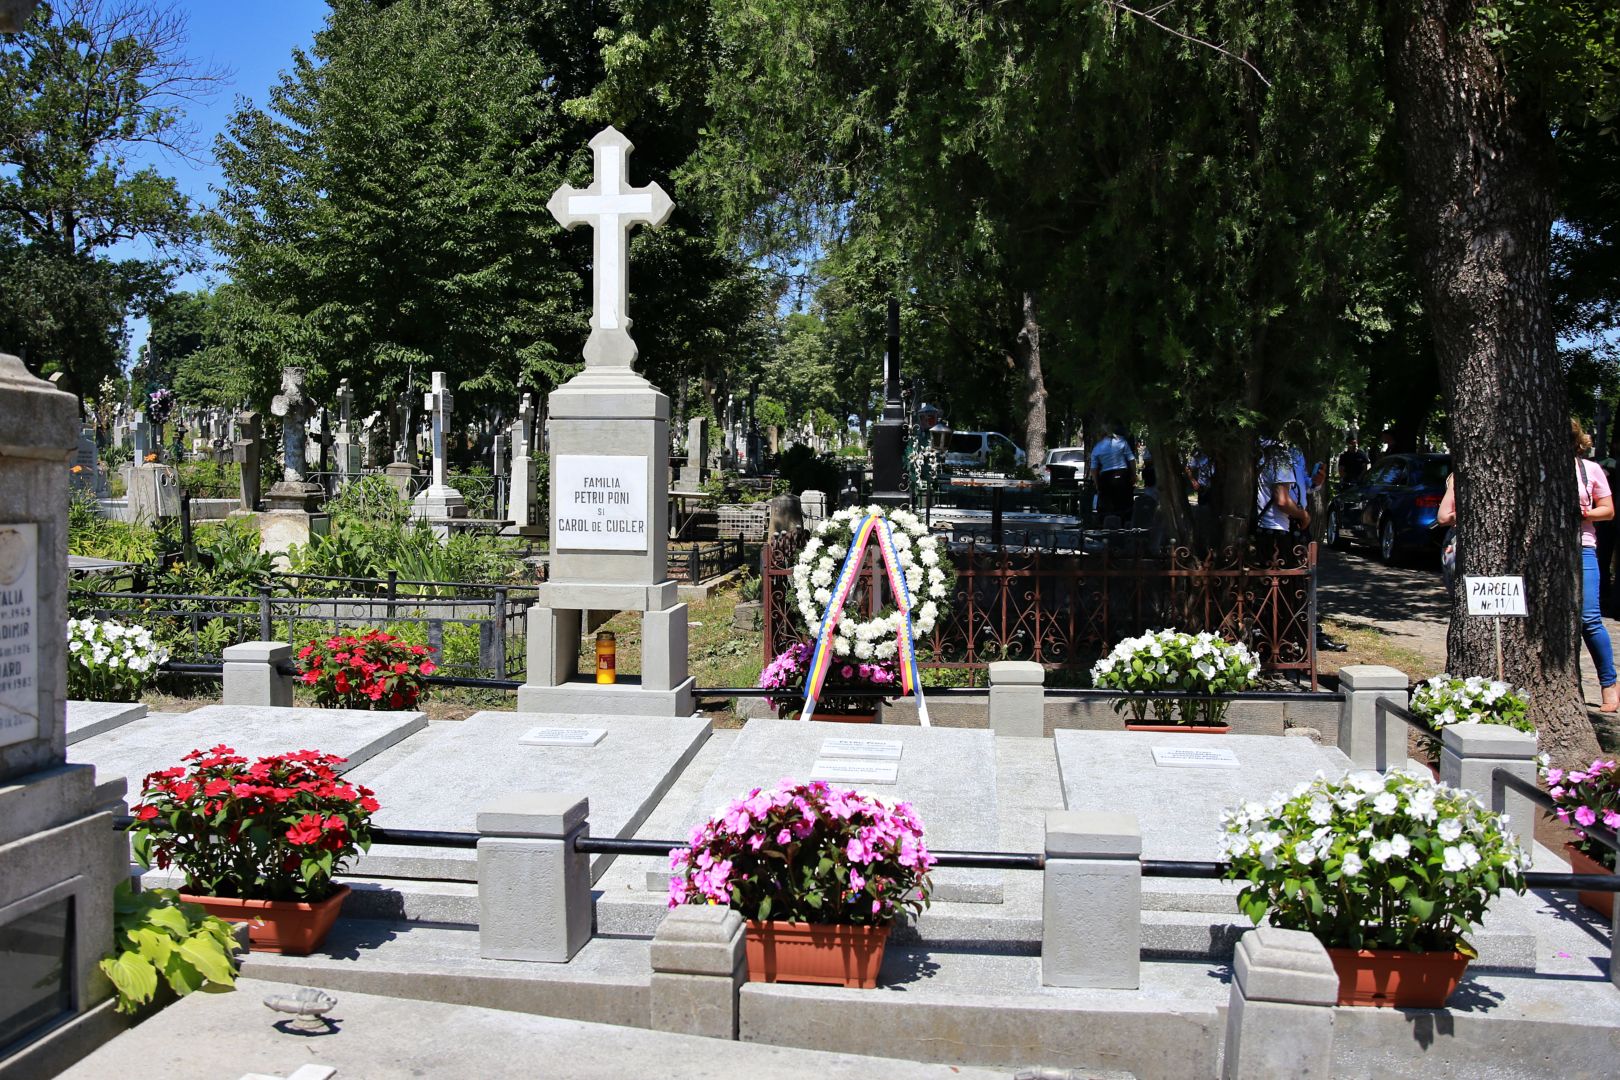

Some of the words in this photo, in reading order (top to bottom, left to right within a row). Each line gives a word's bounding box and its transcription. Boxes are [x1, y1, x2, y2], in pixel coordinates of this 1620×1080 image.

[583, 477, 621, 489] FAMILIA
[574, 491, 604, 504] PETRU
[607, 492, 630, 505] PONI
[558, 518, 589, 532] CAROL
[591, 521, 602, 532] DE
[606, 519, 644, 533] CUGLER
[1472, 582, 1519, 596] PARCELA
[0, 589, 24, 607] ALIA
[0, 622, 30, 640] DIMIR
[0, 660, 22, 678] ARD
